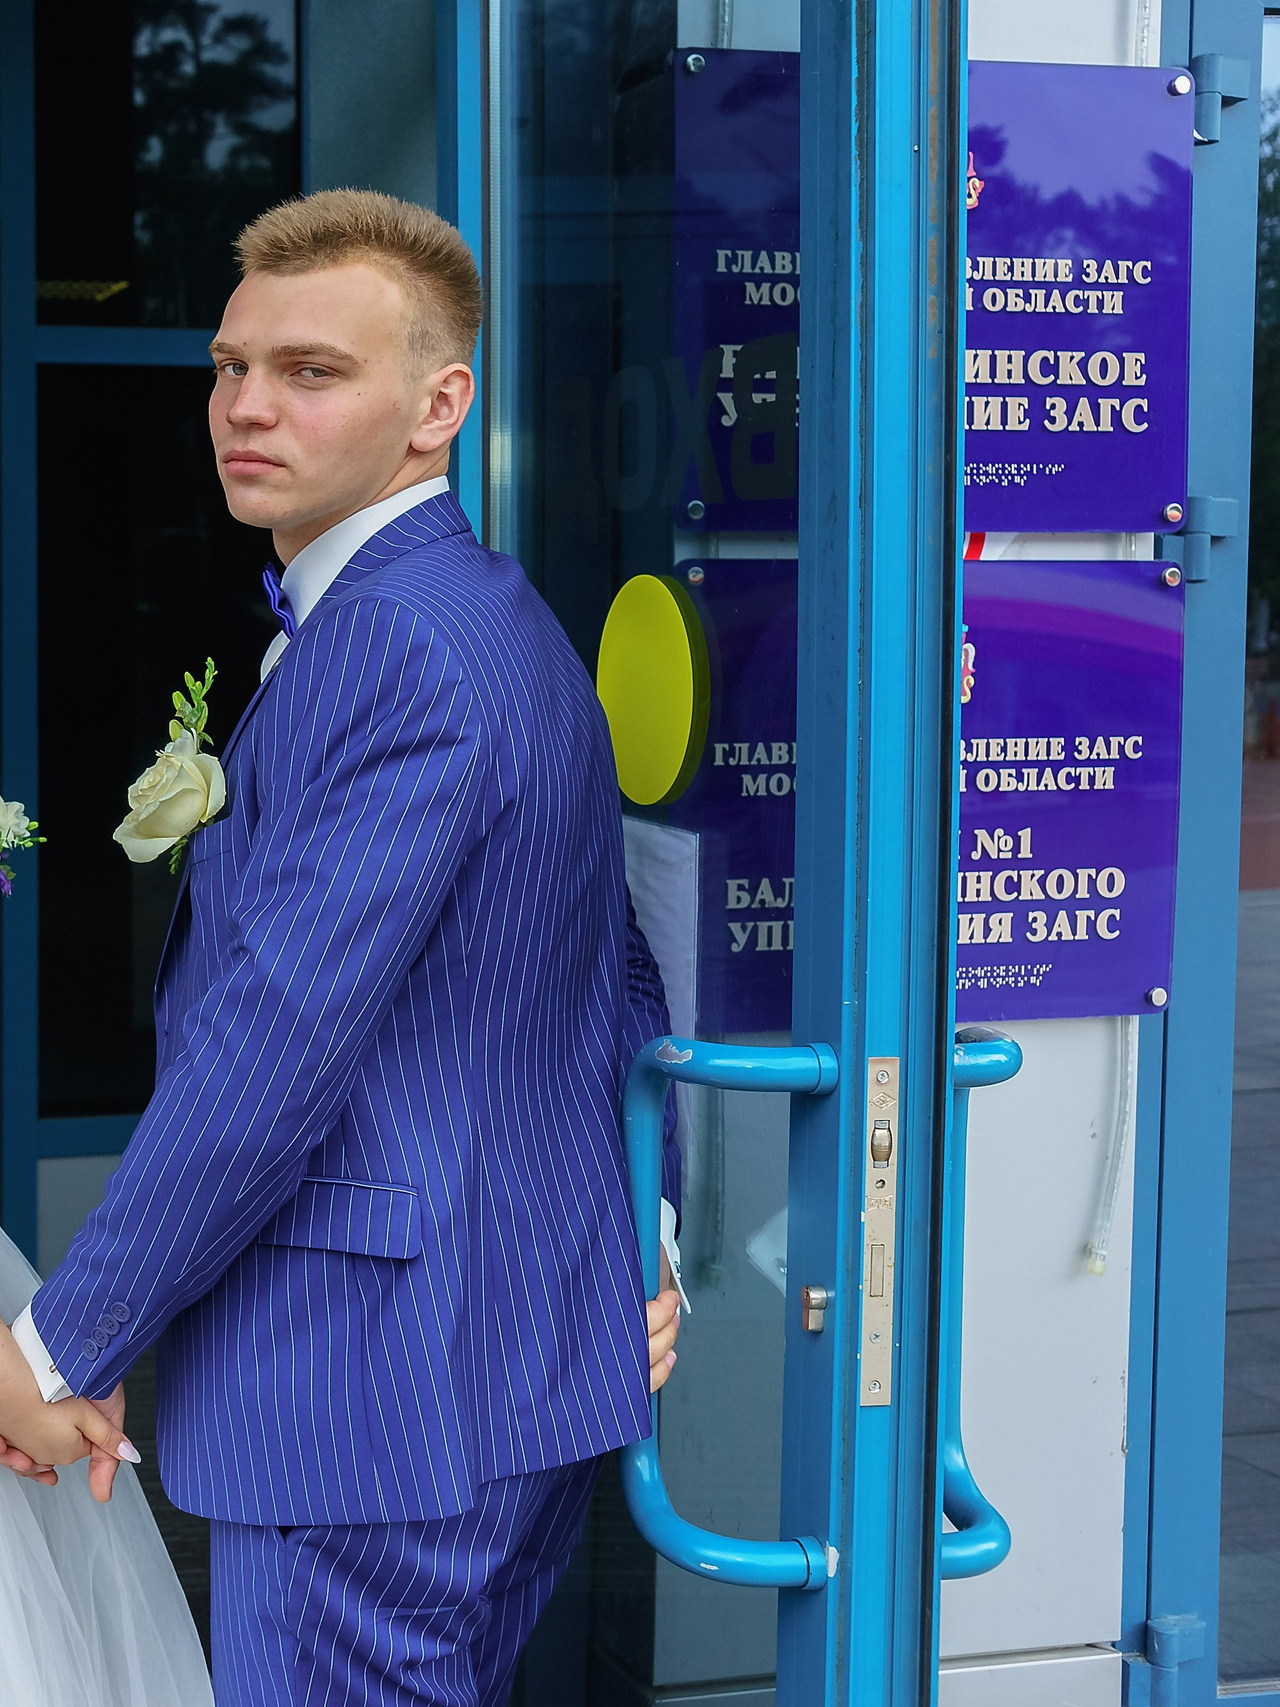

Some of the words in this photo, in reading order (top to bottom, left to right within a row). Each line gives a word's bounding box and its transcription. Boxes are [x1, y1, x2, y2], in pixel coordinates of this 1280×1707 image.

[716, 249, 800, 275] ГЛАВ
[1081, 259, 1152, 285] ЗАГС
[744, 282, 800, 306] МО
[982, 287, 1124, 314] ОБЛАСТИ
[964, 396, 1031, 430] ИЕ
[1043, 396, 1149, 433] ЗАГС
[713, 742, 796, 766] ГЛАВ
[1073, 736, 1143, 761] ЗАГС
[741, 773, 796, 797] МО
[975, 766, 1116, 793] ОБЛАСТИ
[970, 827, 1033, 861] №1
[957, 866, 1126, 903] НСКОГО
[727, 920, 795, 953] УП
[1025, 908, 1120, 943] ЗАГС
